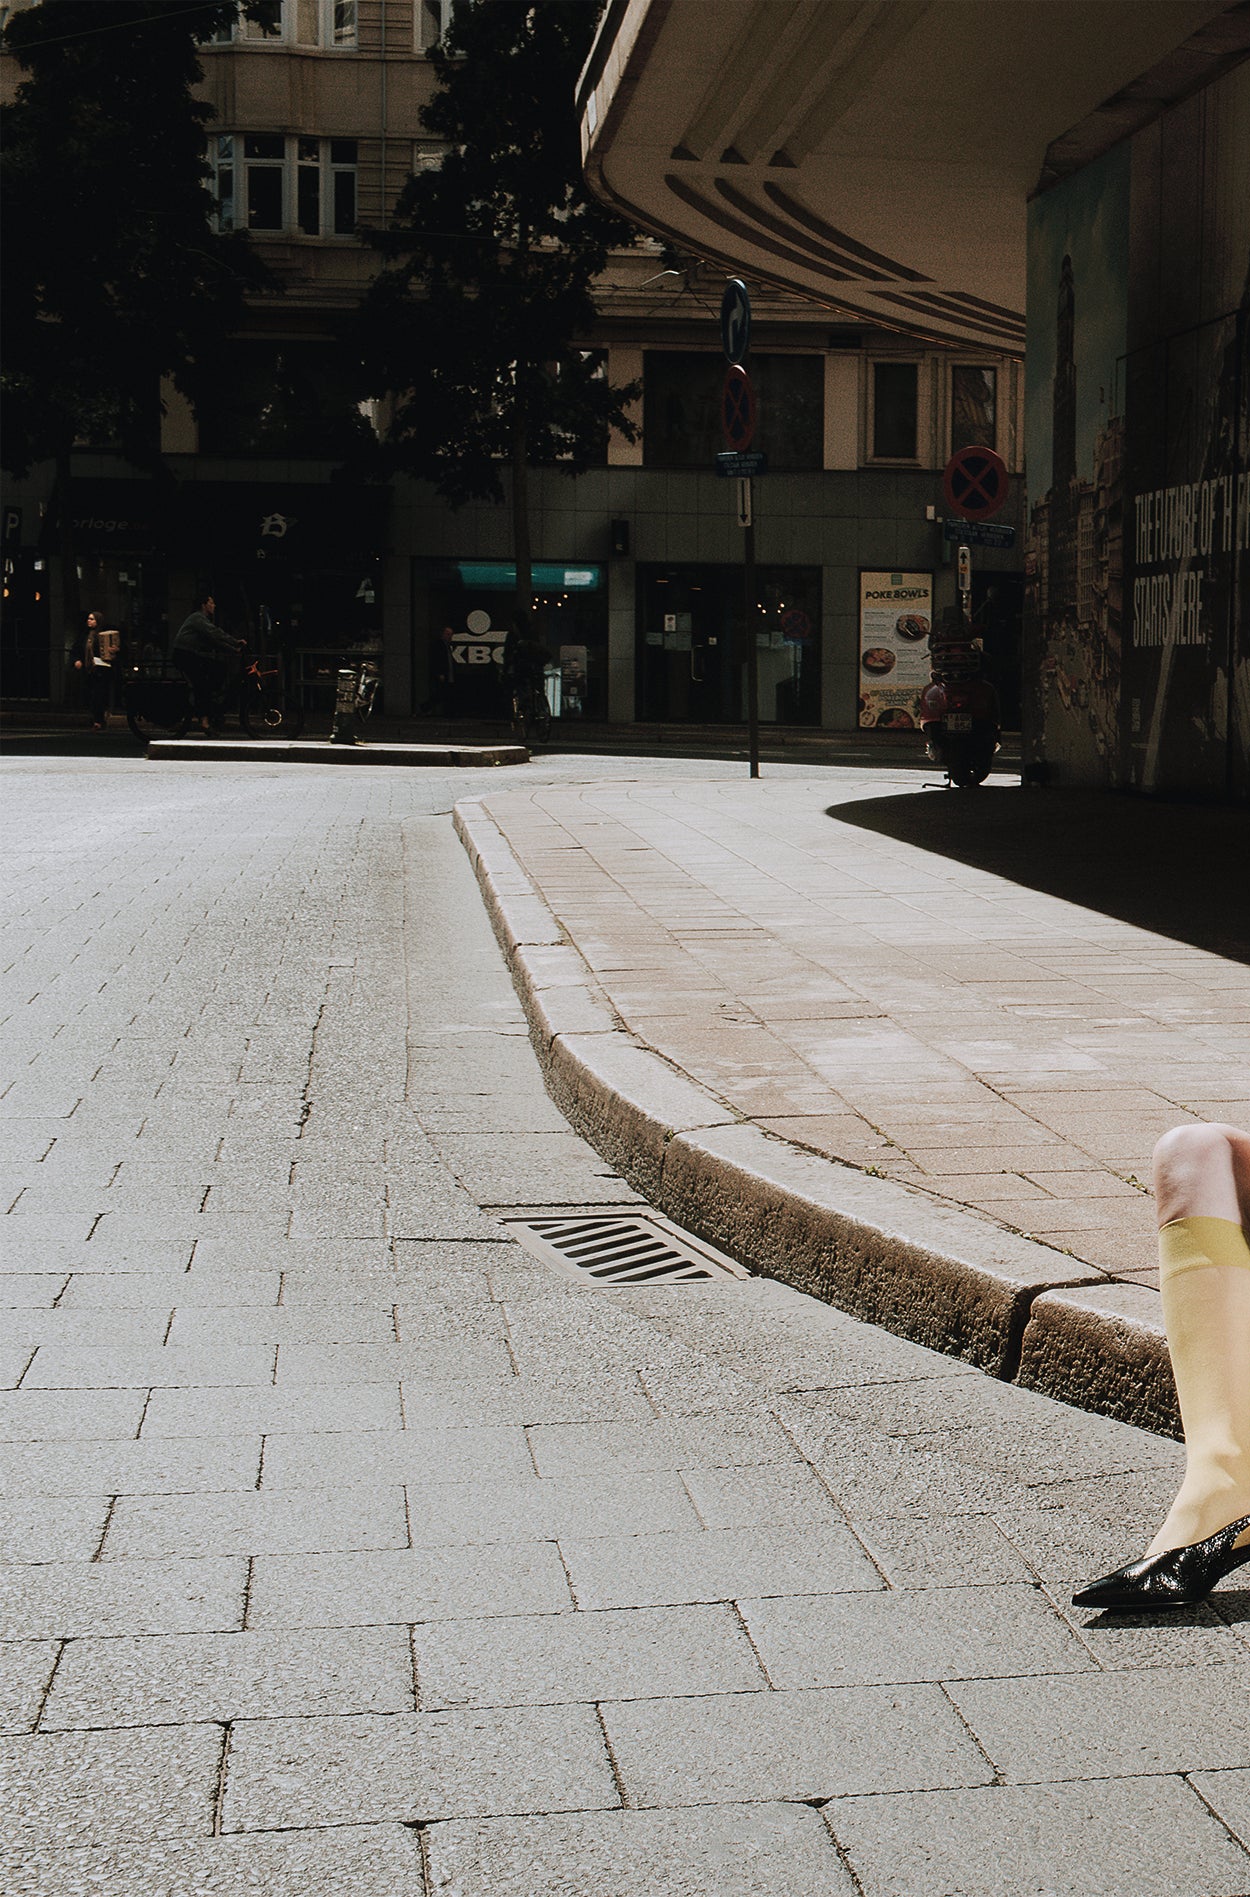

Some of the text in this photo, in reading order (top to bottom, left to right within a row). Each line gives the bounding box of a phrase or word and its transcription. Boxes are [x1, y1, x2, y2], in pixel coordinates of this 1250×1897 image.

[1134, 493, 1154, 565] THE
[1154, 483, 1200, 562] FUTURE
[1200, 478, 1218, 556] OF
[1218, 472, 1244, 553] HE
[865, 589, 929, 600] POKE BOWLS
[1132, 569, 1206, 648] STARTS HERE.
